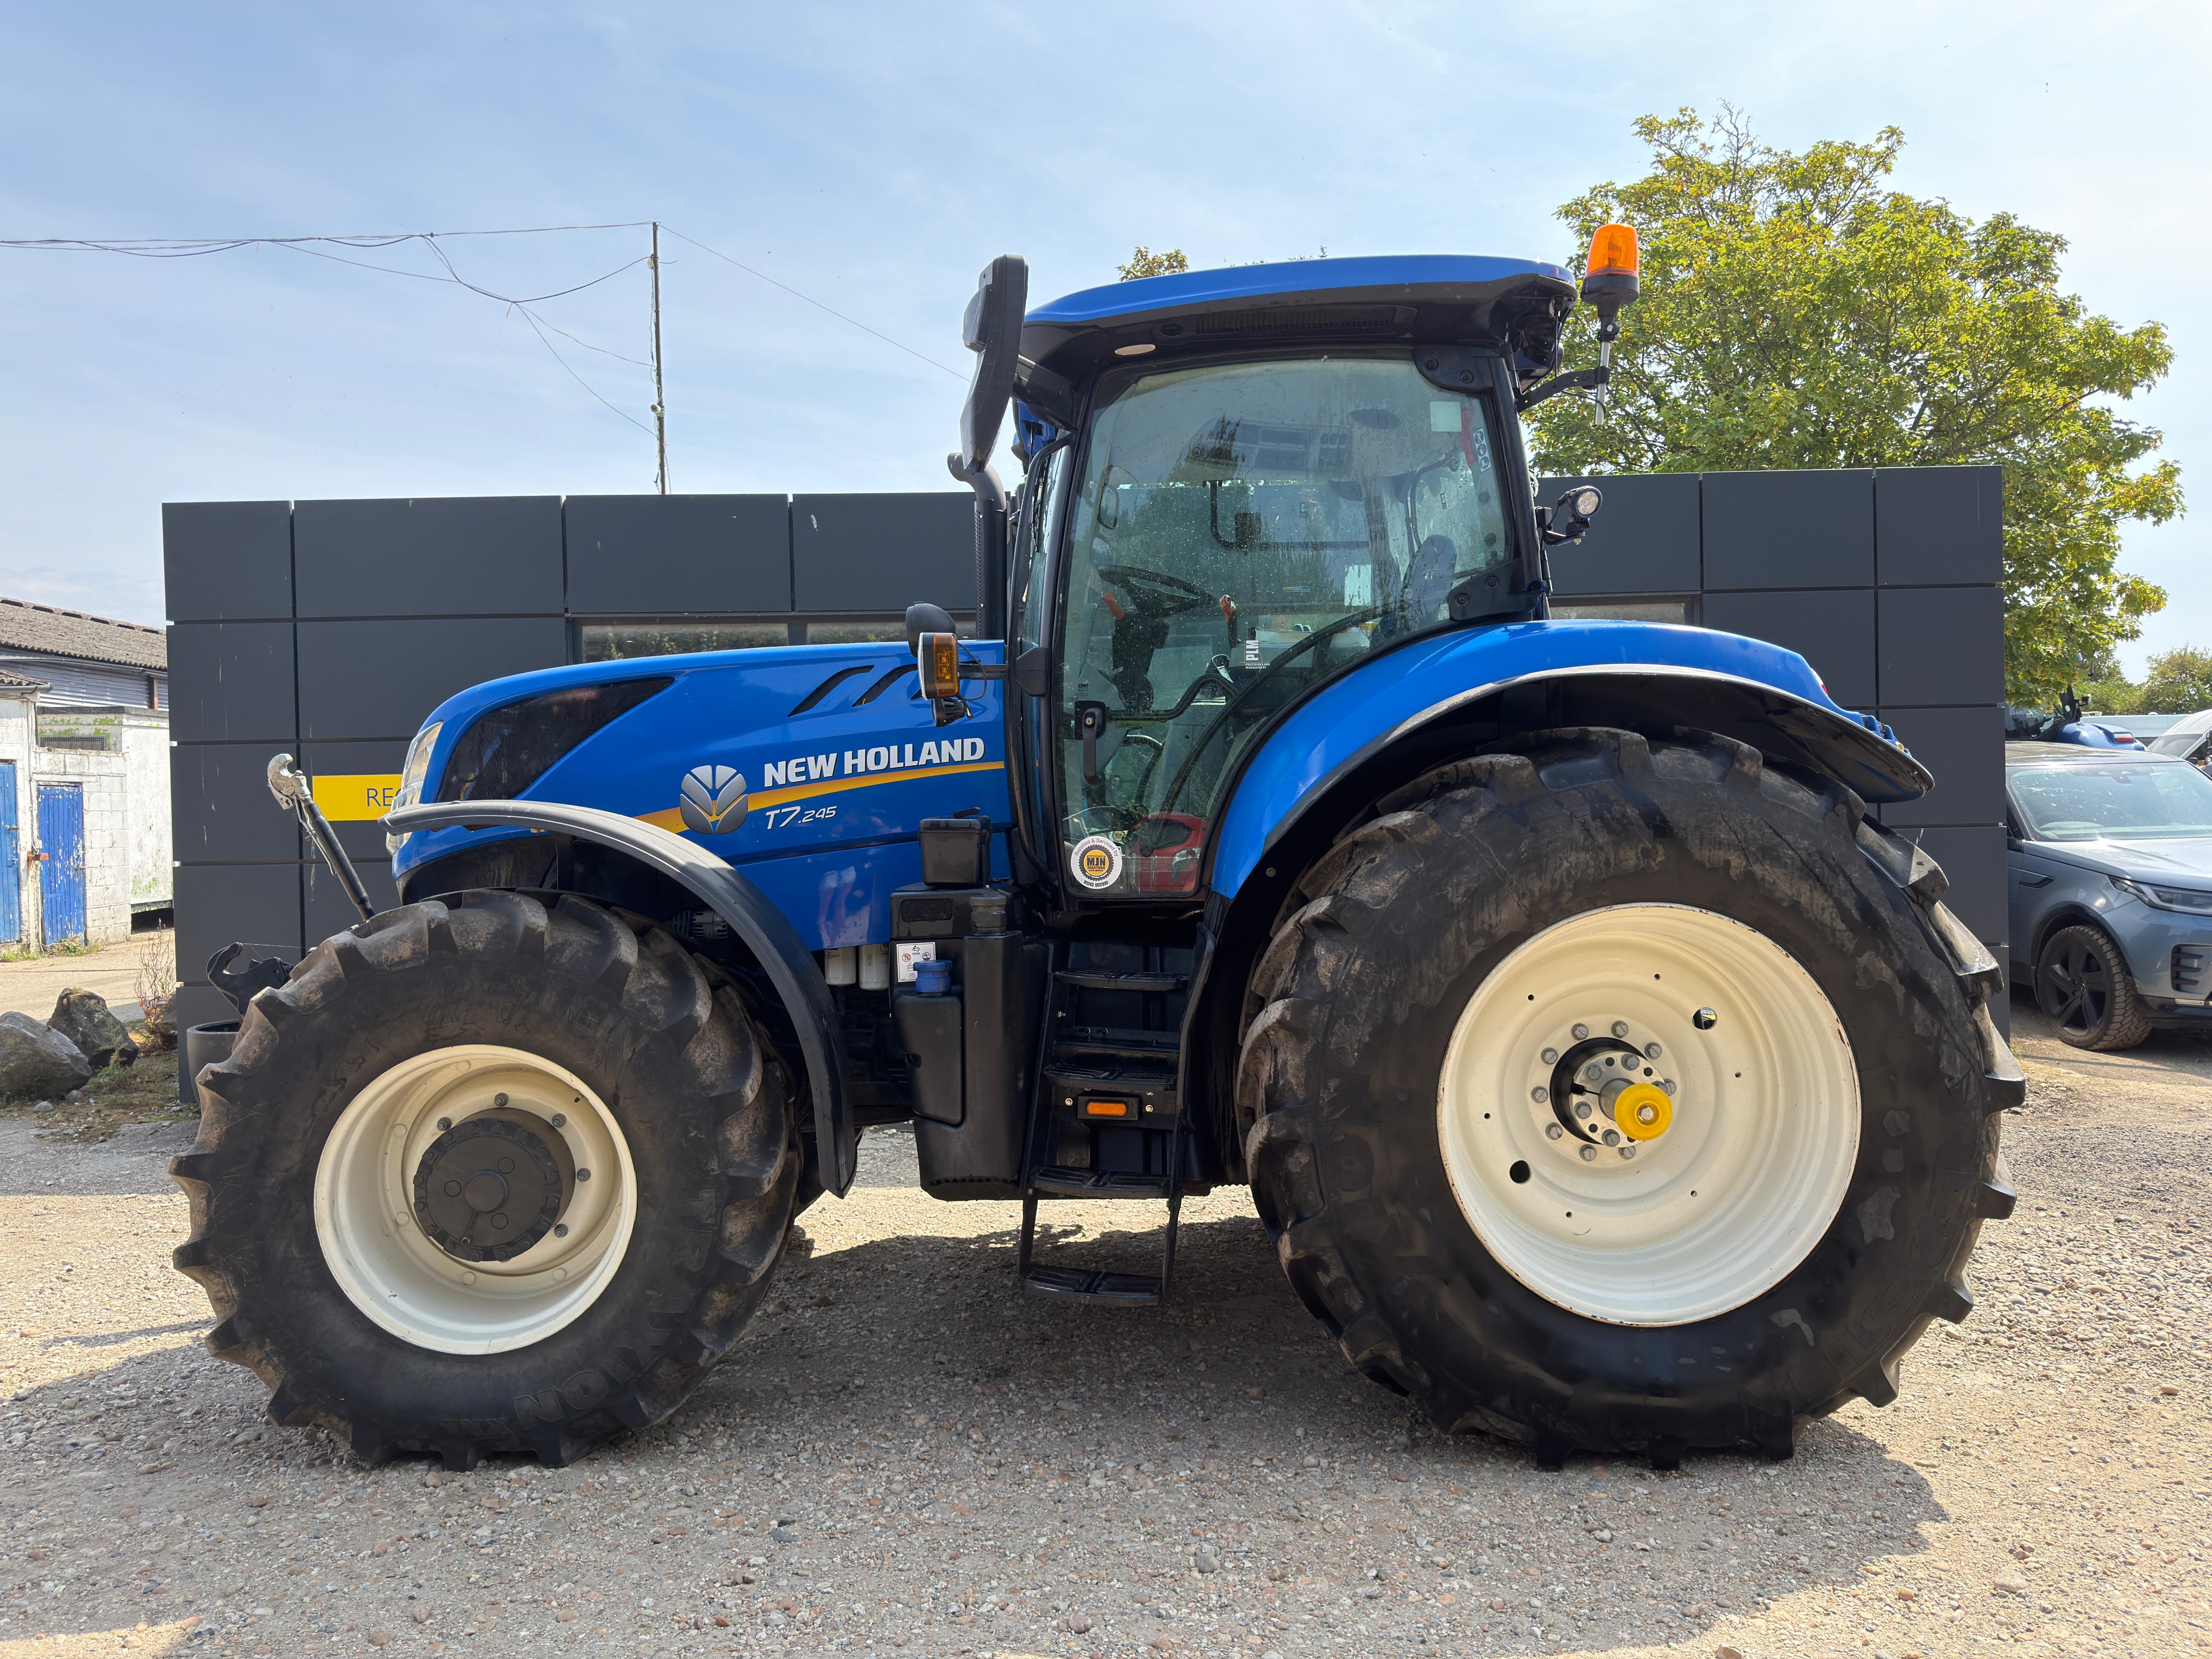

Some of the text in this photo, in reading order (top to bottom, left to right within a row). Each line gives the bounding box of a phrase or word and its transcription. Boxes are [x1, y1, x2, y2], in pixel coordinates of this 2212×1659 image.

[1246, 640, 1259, 661] PLM
[765, 738, 984, 787] NEW HOLLAND
[367, 788, 402, 807] RE
[766, 806, 837, 830] T7.245
[1074, 840, 1090, 855] Supplied
[1096, 839, 1115, 850] Serviced
[1087, 858, 1105, 866] MJN
